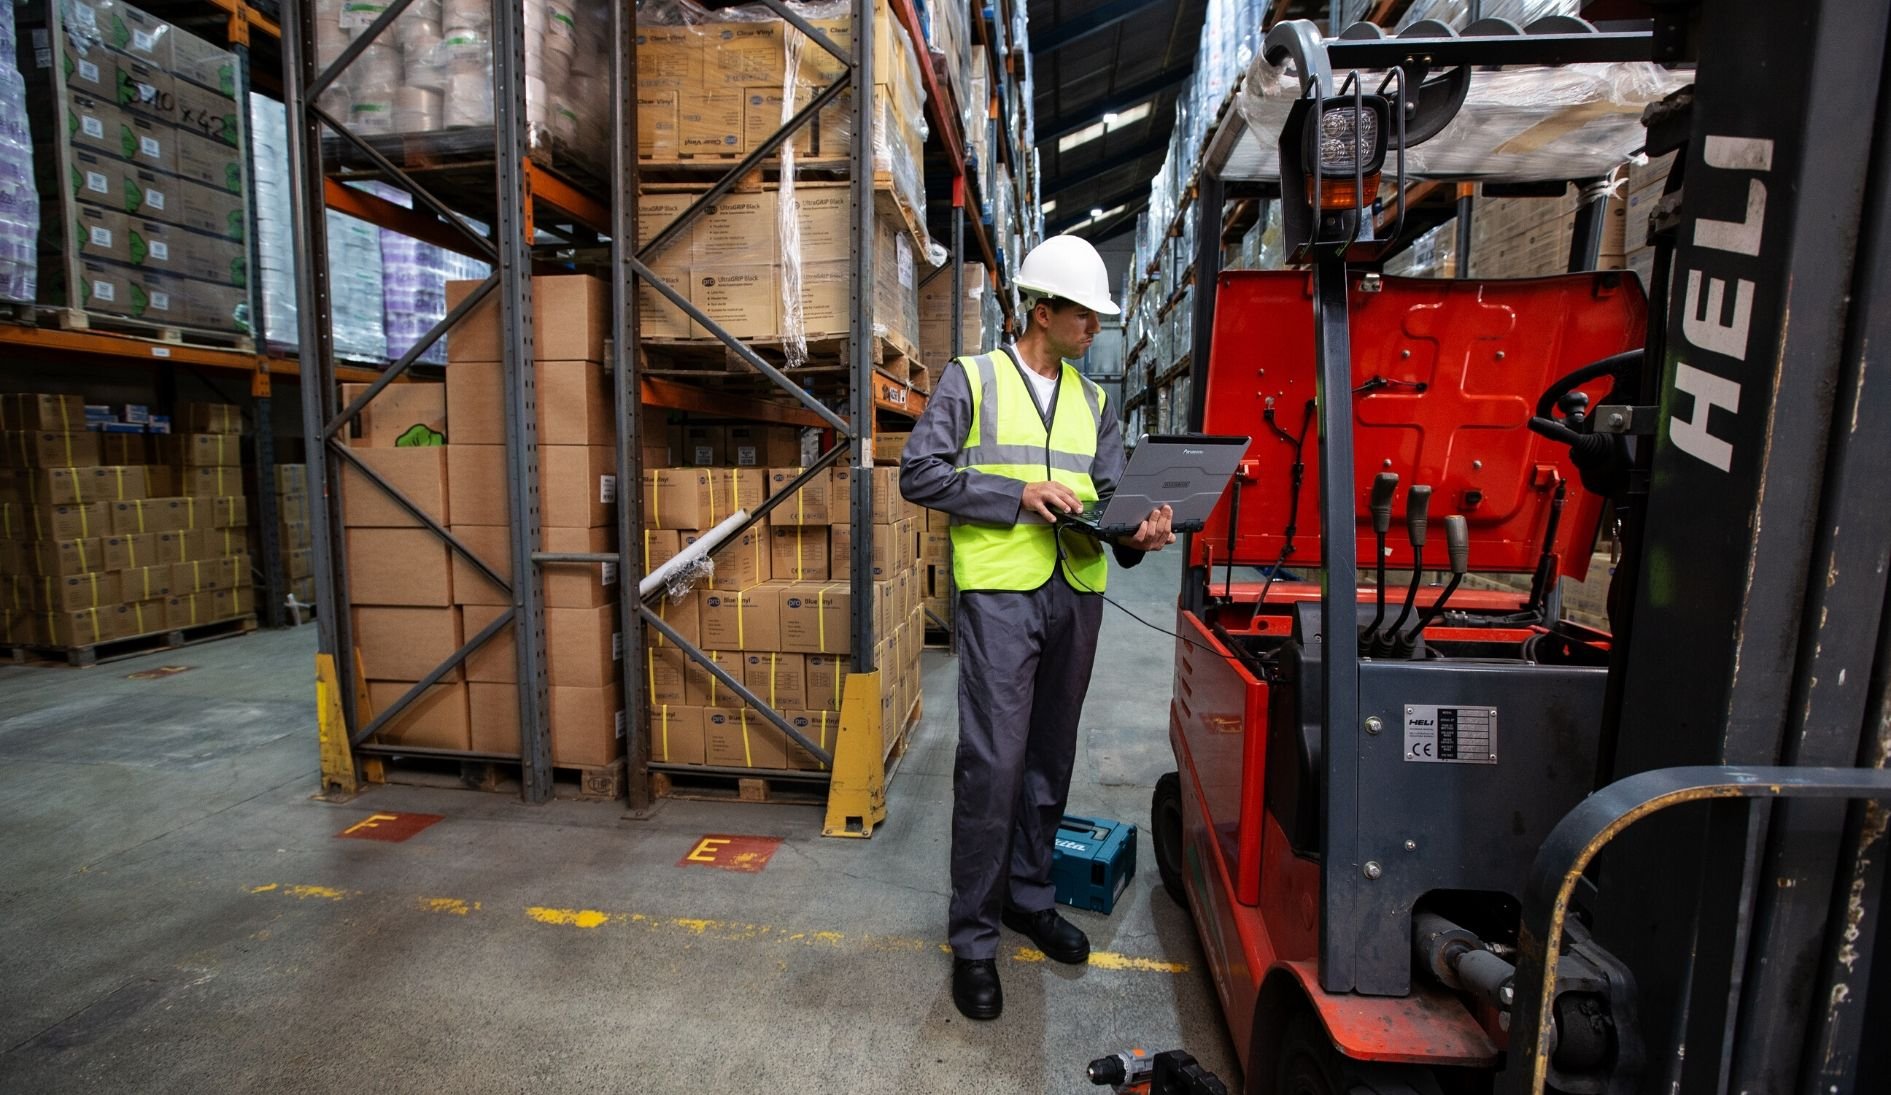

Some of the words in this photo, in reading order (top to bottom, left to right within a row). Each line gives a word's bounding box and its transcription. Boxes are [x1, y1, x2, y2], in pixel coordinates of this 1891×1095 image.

[703, 278, 715, 287] pro
[1669, 134, 1775, 473] HELI
[708, 597, 720, 607] pro
[786, 599, 801, 608] pro
[712, 715, 725, 724] pro
[794, 718, 807, 727] pro
[344, 814, 398, 834] F
[687, 838, 731, 861] E
